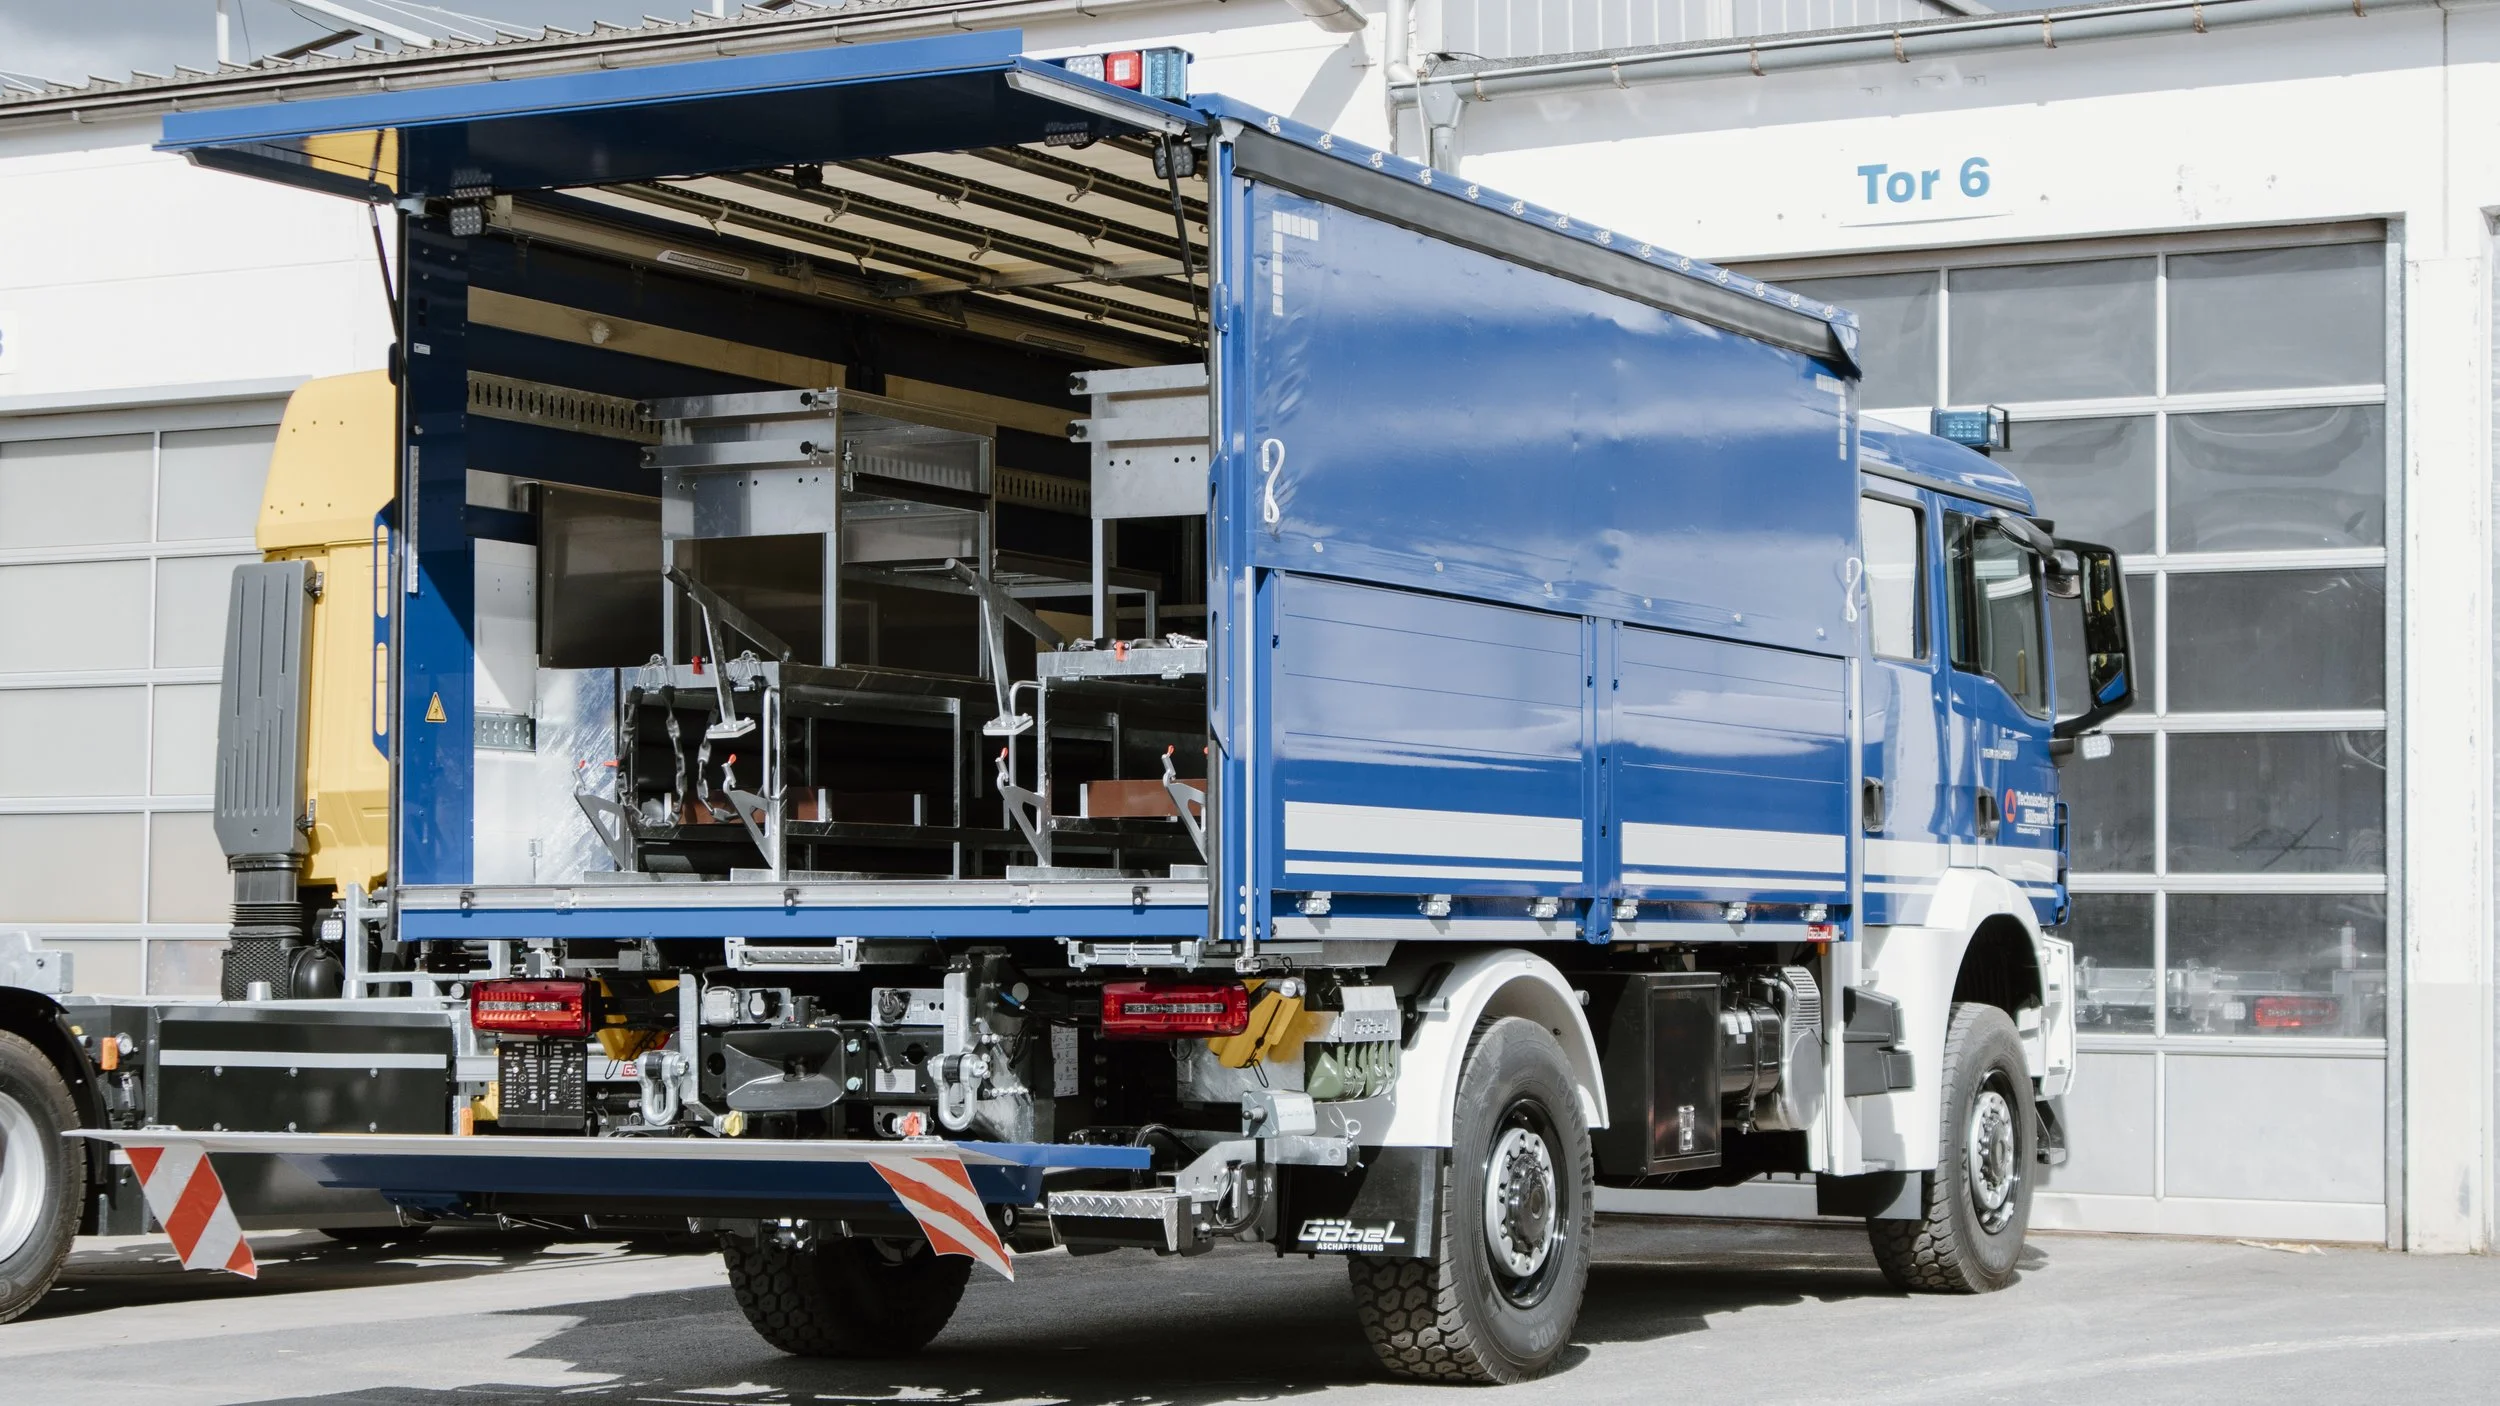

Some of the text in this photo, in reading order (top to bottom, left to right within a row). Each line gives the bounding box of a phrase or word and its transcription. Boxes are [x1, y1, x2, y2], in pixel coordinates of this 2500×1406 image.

[1857, 156, 1991, 204] Tor 6
[1316, 1243, 1384, 1252] ASCHAFFENBURG
